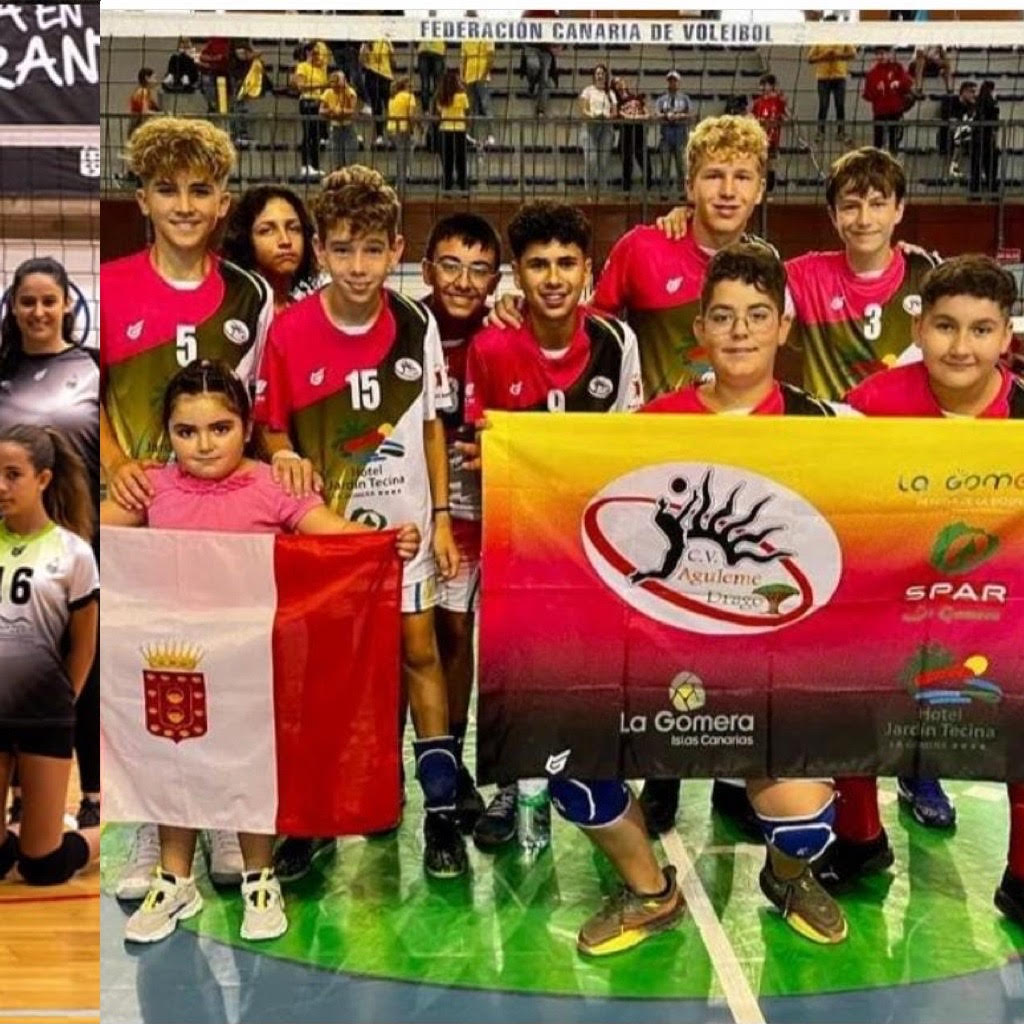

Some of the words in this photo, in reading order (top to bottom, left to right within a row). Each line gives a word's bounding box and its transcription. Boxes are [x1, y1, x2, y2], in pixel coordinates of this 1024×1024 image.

[35, 4, 83, 30] EN
[553, 22, 641, 40] CANARIA
[651, 23, 672, 40] DE
[683, 23, 774, 42] VOLEIBOL
[864, 303, 882, 340] 3
[177, 325, 197, 367] 5
[345, 369, 381, 410] 15
[905, 582, 1007, 602] SPAR
[620, 711, 647, 733] La
[654, 710, 754, 732] Gomera
[919, 706, 962, 721] Hotel
[671, 735, 698, 745] Islas
[701, 734, 754, 745] Canarias
[940, 722, 996, 738] Tecina
